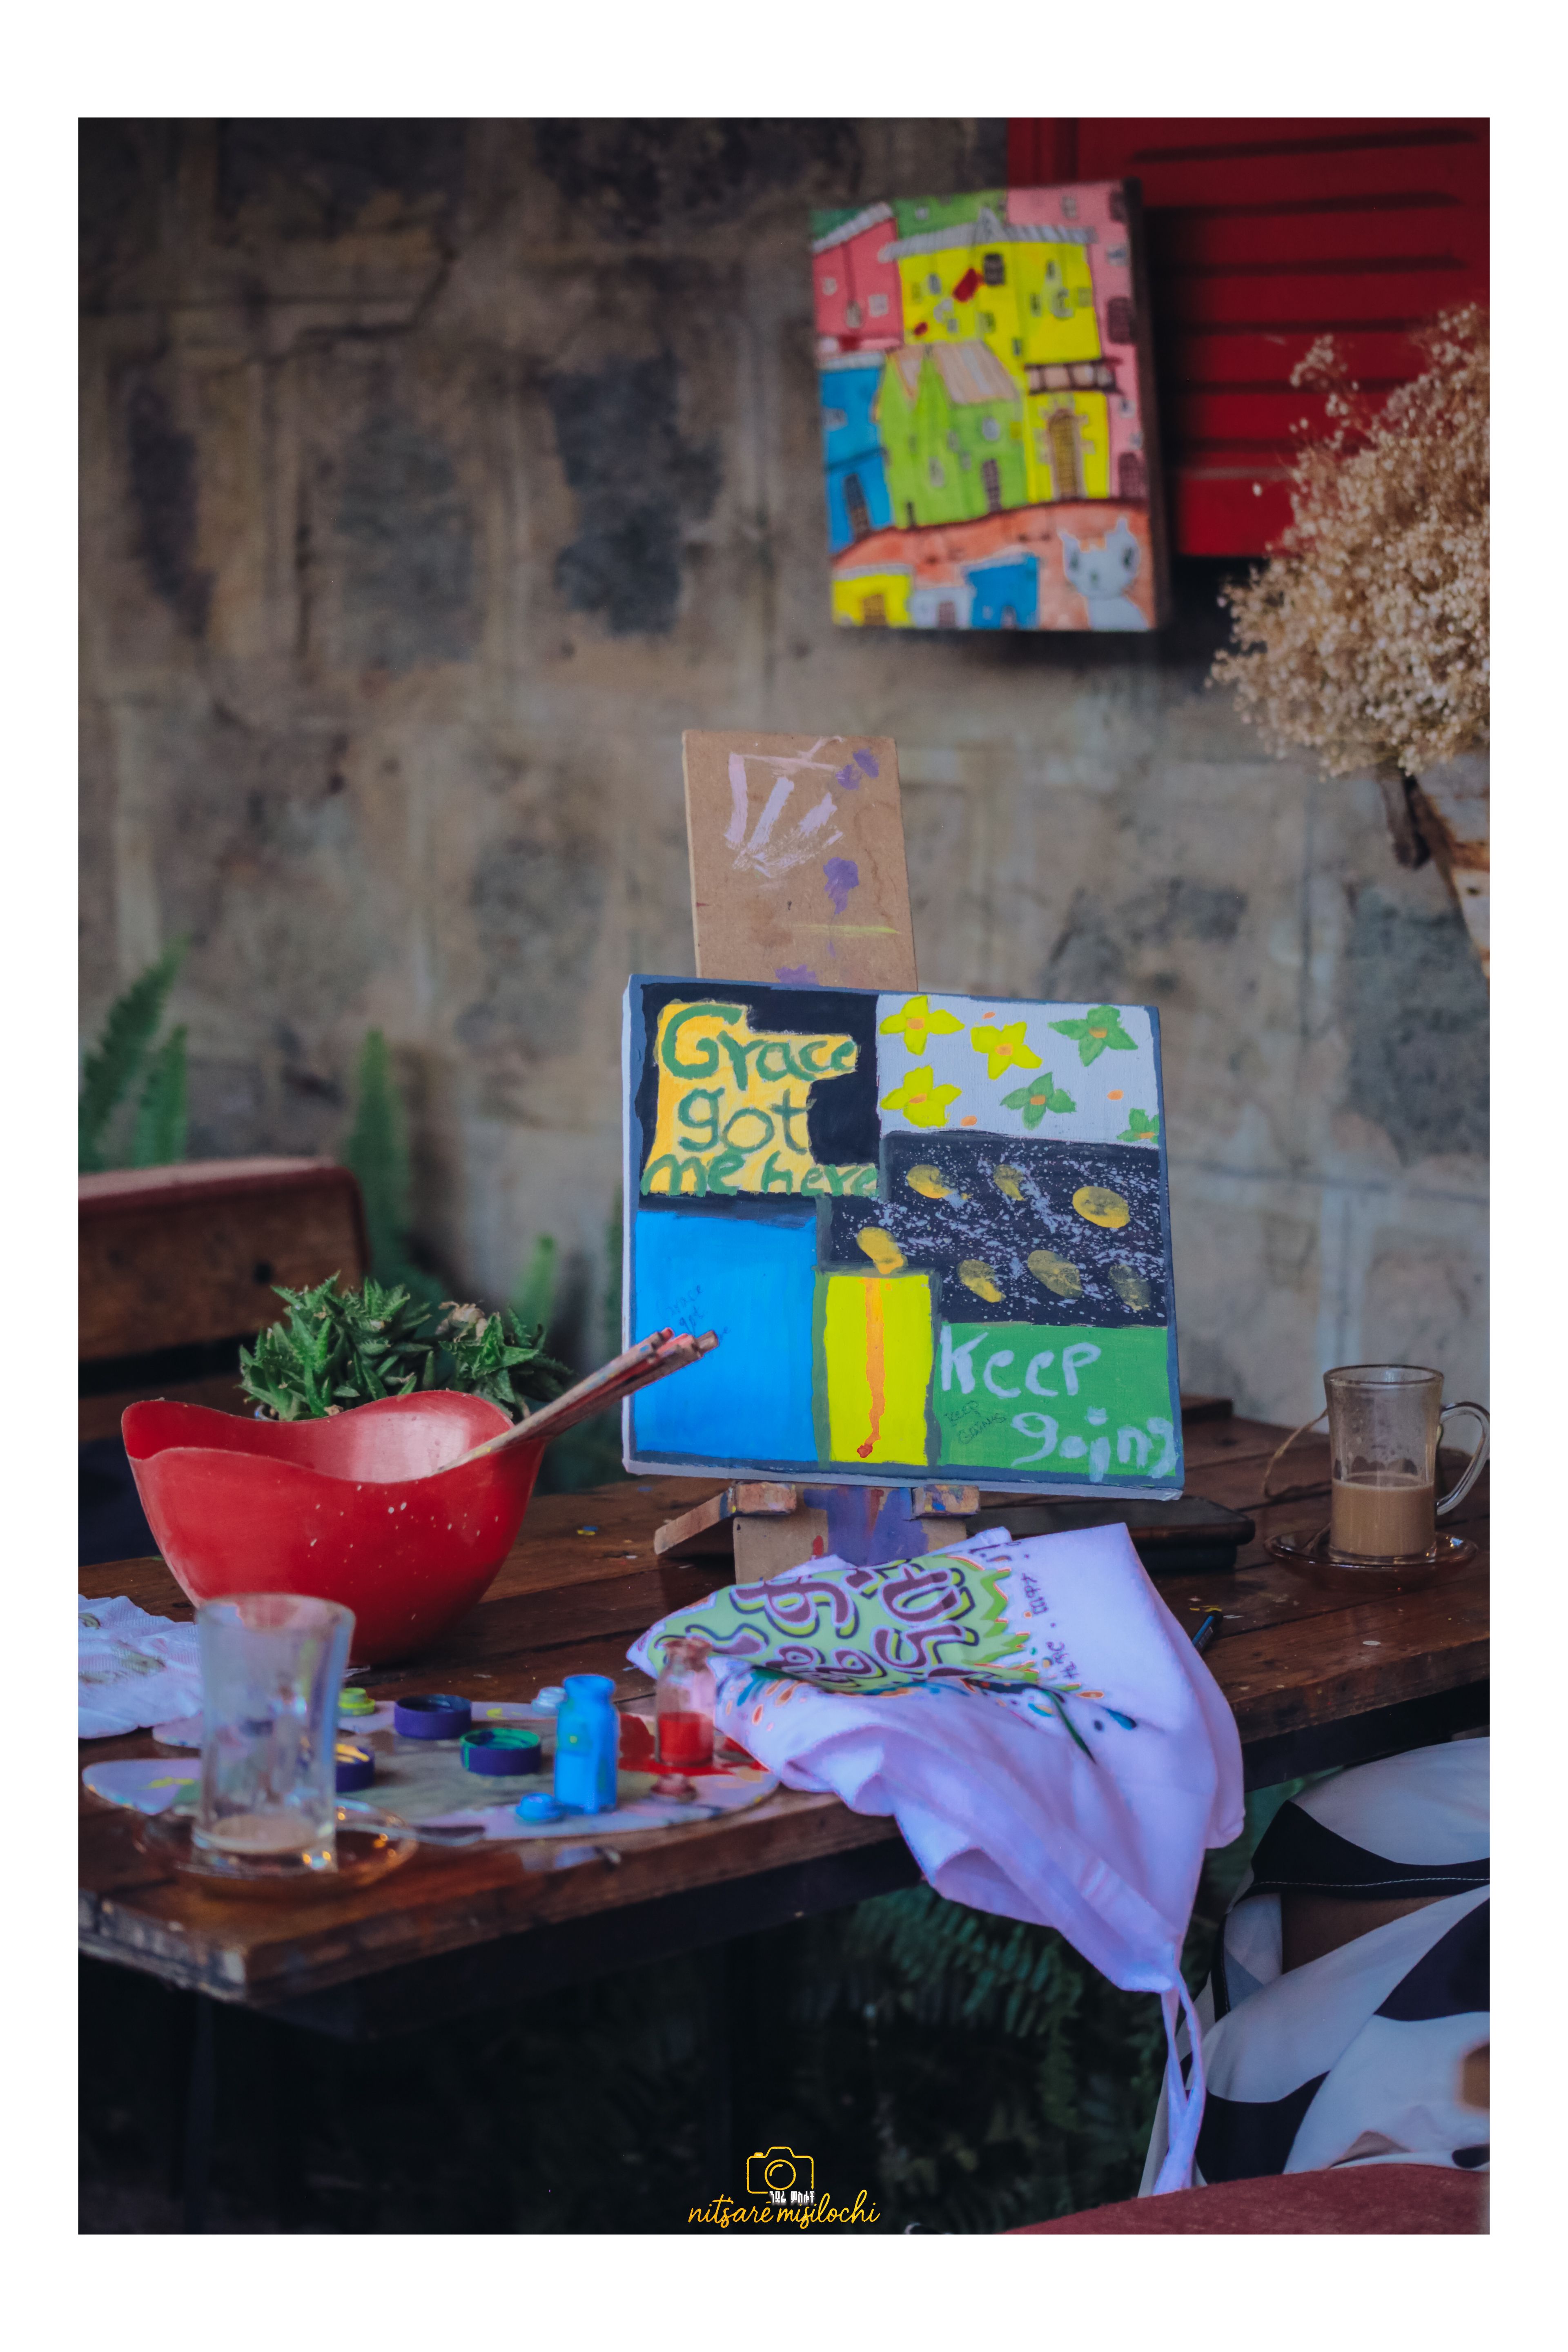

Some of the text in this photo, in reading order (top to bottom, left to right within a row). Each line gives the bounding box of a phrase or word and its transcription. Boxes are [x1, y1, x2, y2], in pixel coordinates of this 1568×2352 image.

[661, 1004, 857, 1091] Grace
[677, 1087, 817, 1156] got
[760, 1150, 879, 1197] here
[1010, 1407, 1178, 1483] going
